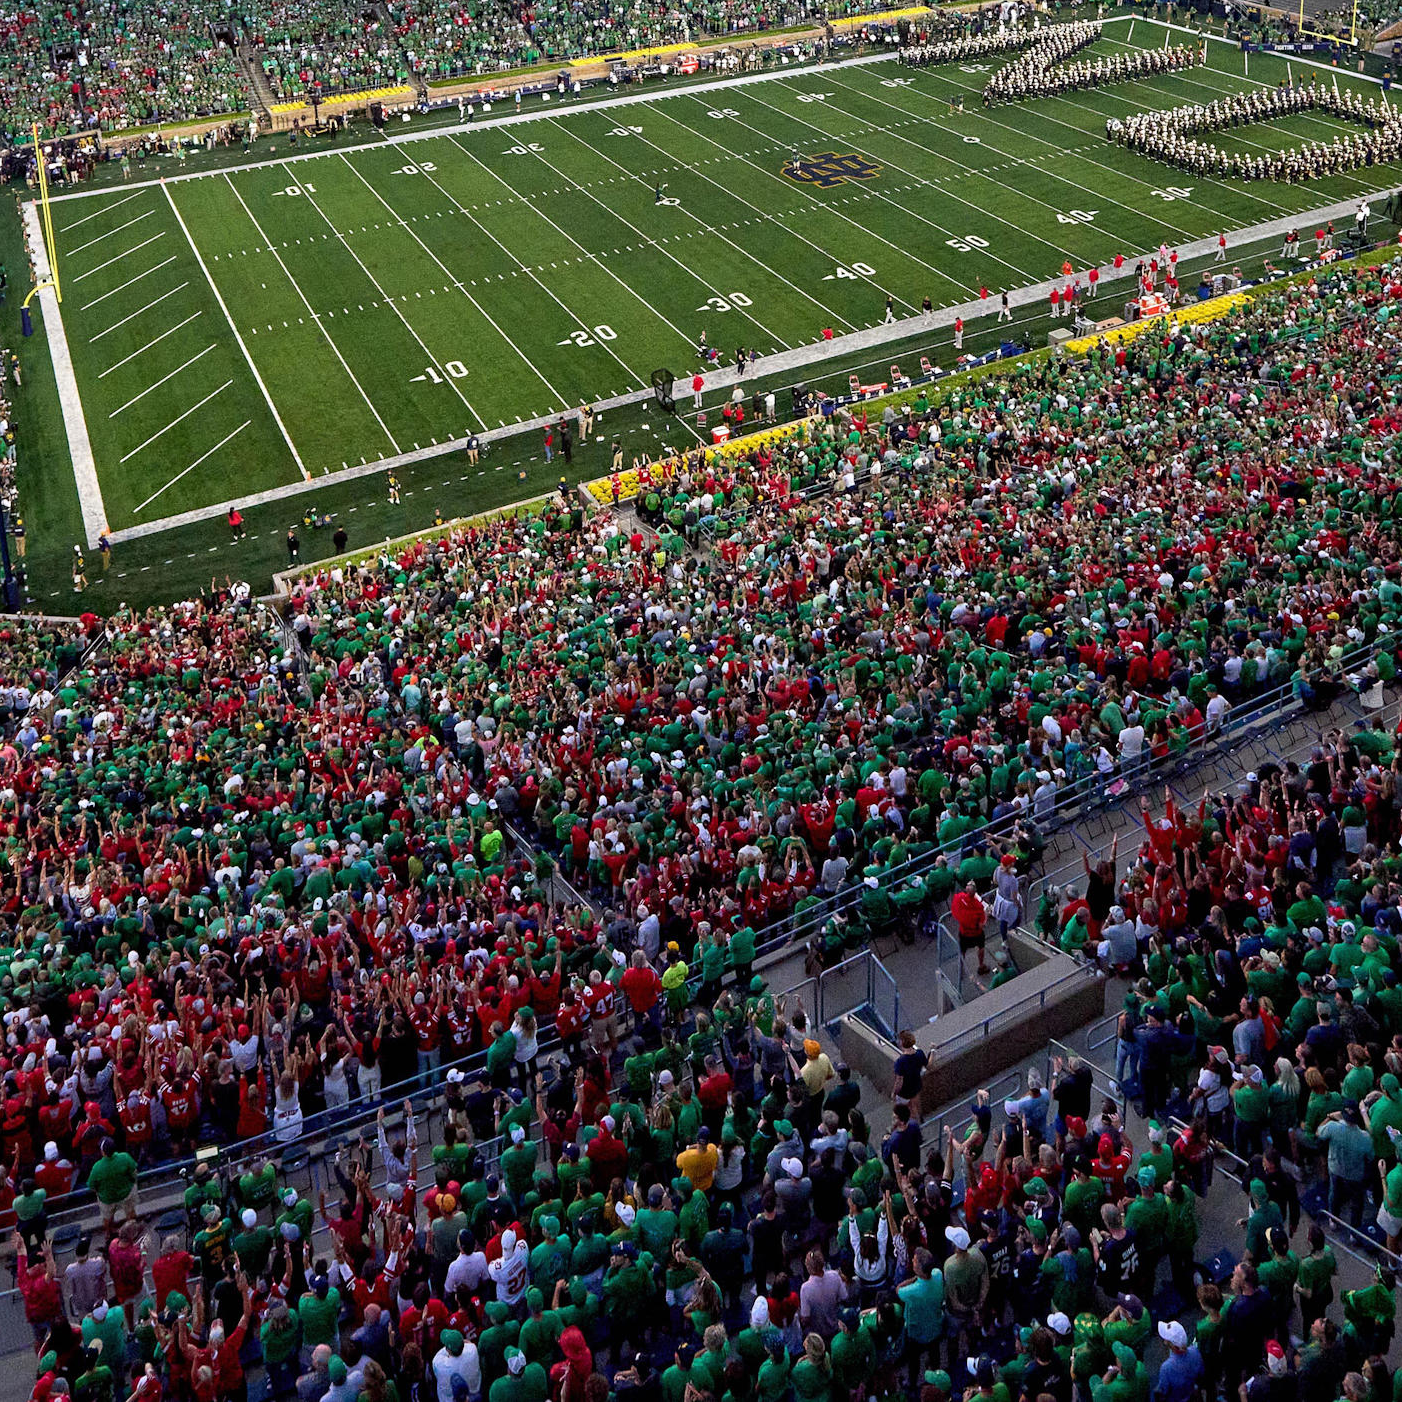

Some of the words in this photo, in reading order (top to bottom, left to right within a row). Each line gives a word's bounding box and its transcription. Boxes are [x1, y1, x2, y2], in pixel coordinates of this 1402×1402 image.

[1151, 186, 1190, 200] 30
[1057, 209, 1094, 225] 40
[945, 235, 990, 252] 50
[836, 262, 877, 280] 40
[707, 292, 753, 312] 30
[570, 324, 618, 348] 20
[425, 360, 469, 384] 10
[596, 992, 614, 1015] 47
